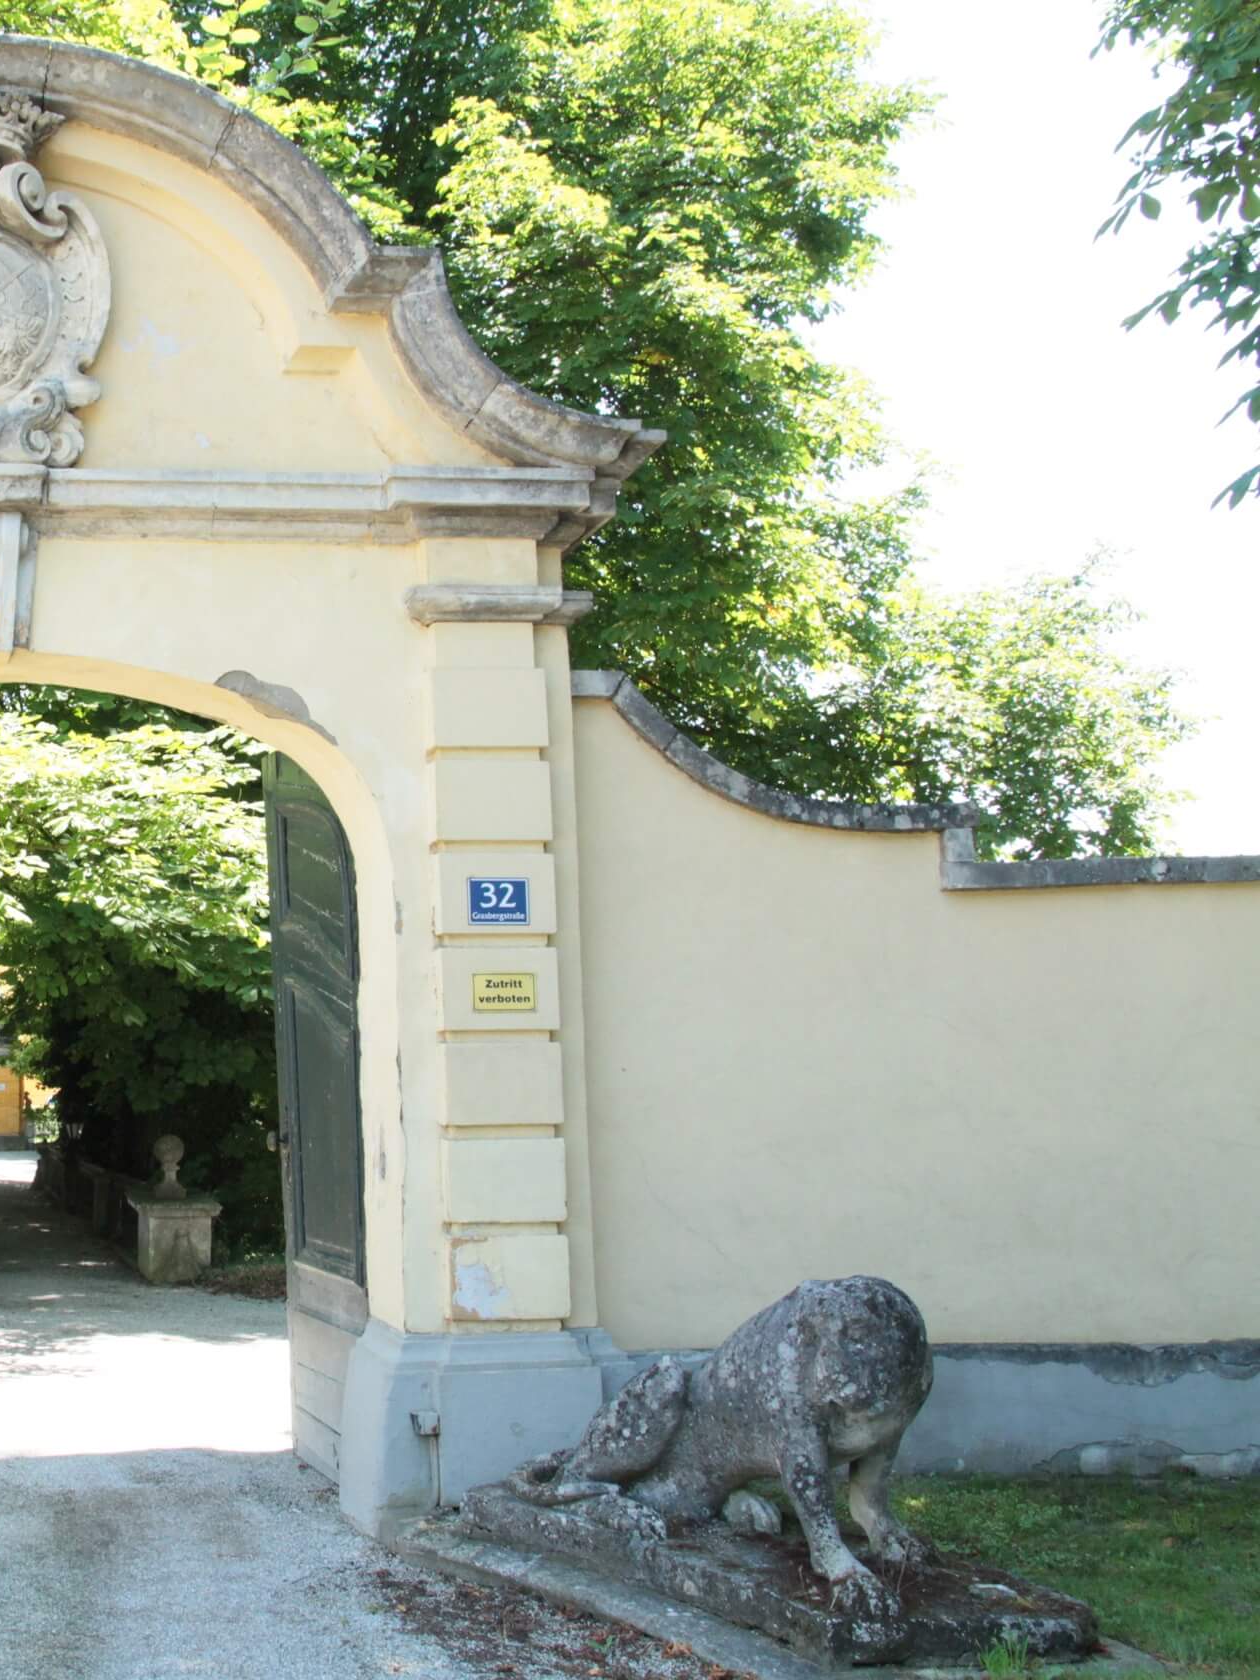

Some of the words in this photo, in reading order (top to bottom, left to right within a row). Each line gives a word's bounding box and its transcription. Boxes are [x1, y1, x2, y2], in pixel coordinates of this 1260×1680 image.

[479, 882, 517, 908] 32
[484, 979, 523, 989] Zutritt
[478, 994, 531, 1003] verboten
